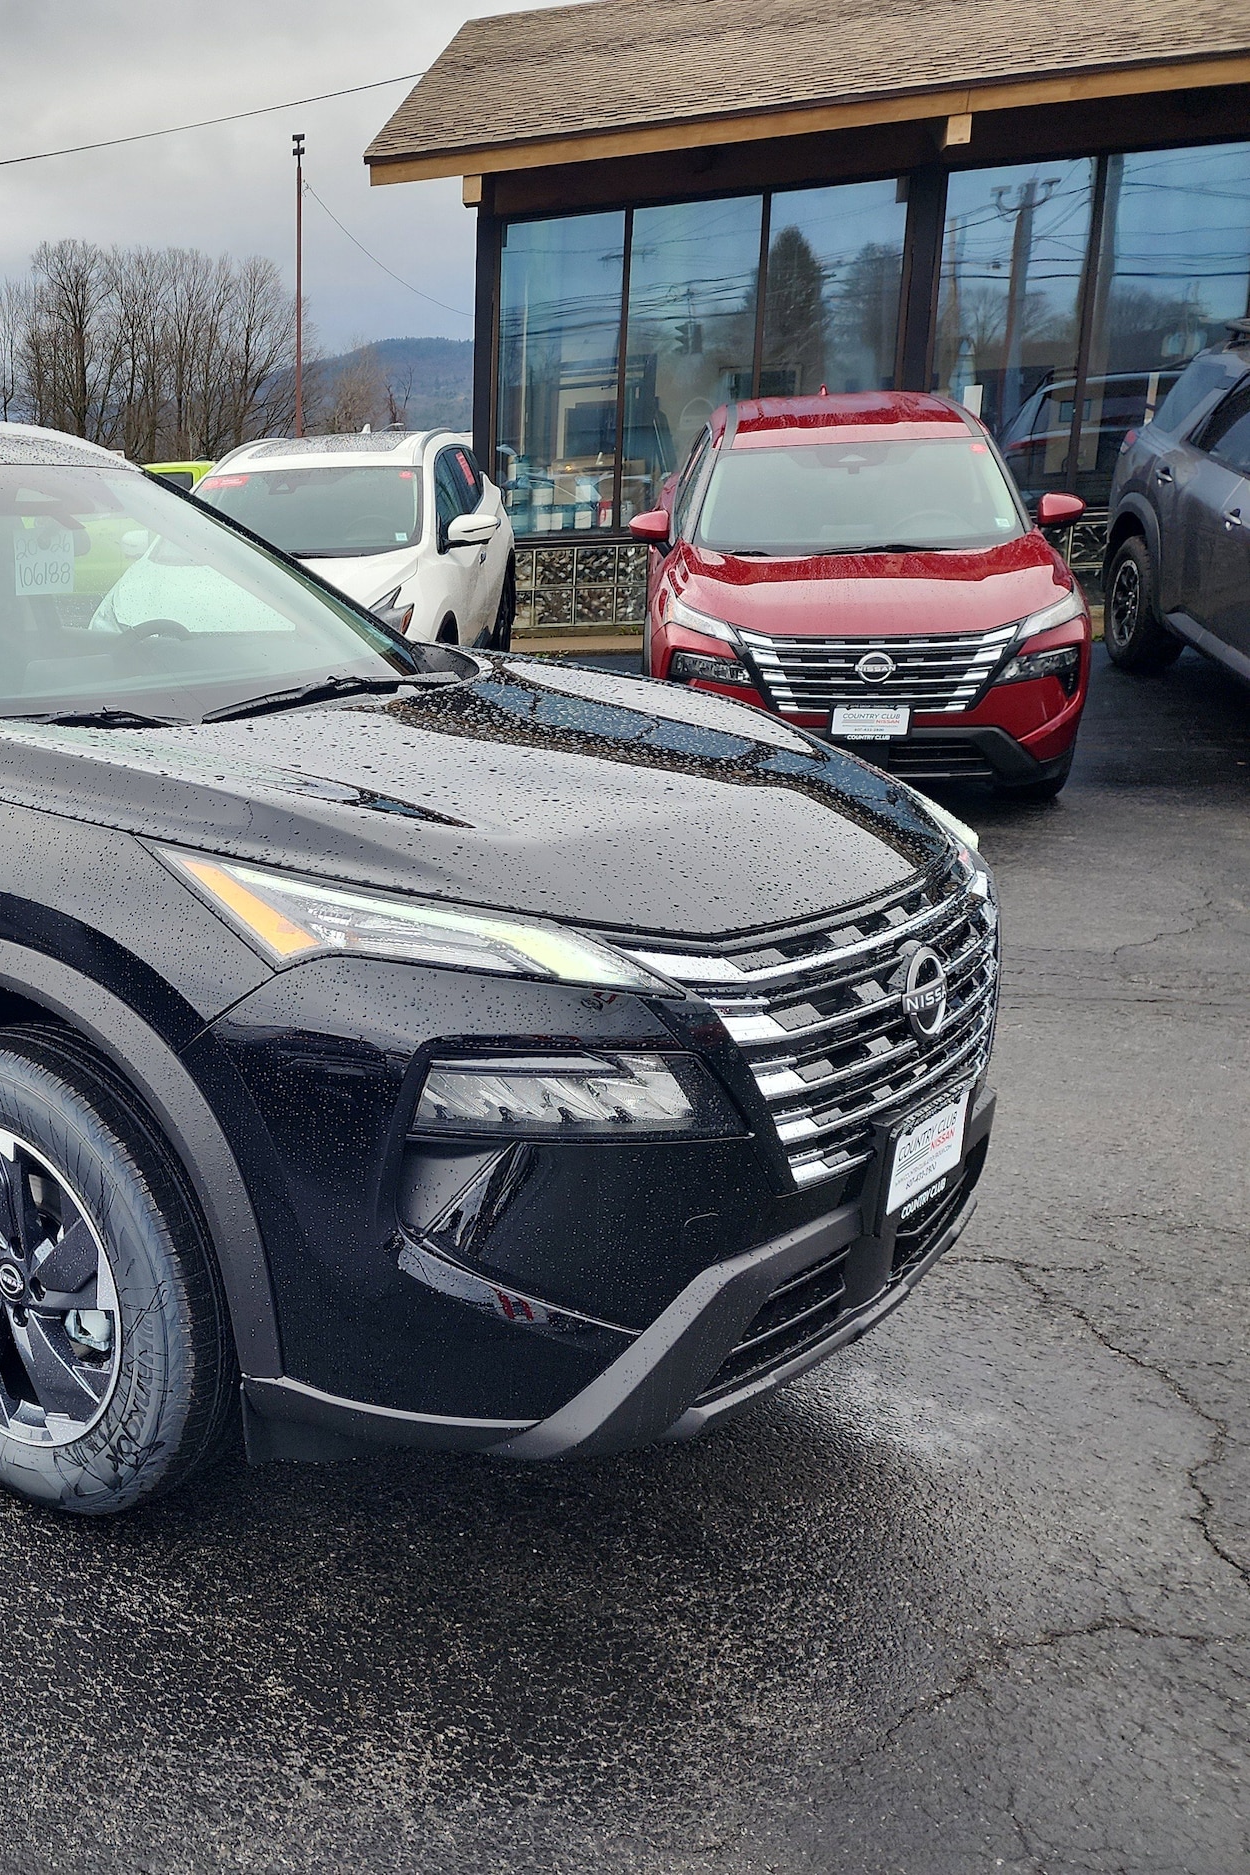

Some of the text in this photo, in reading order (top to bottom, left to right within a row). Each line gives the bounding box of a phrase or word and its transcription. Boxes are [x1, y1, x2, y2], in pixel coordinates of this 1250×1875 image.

[19, 561, 70, 588] 106188
[899, 1111, 958, 1161] COUNTRY CLUB
[930, 1127, 955, 1151] NISSAN
[901, 1177, 947, 1219] COUNTRY CLUB
